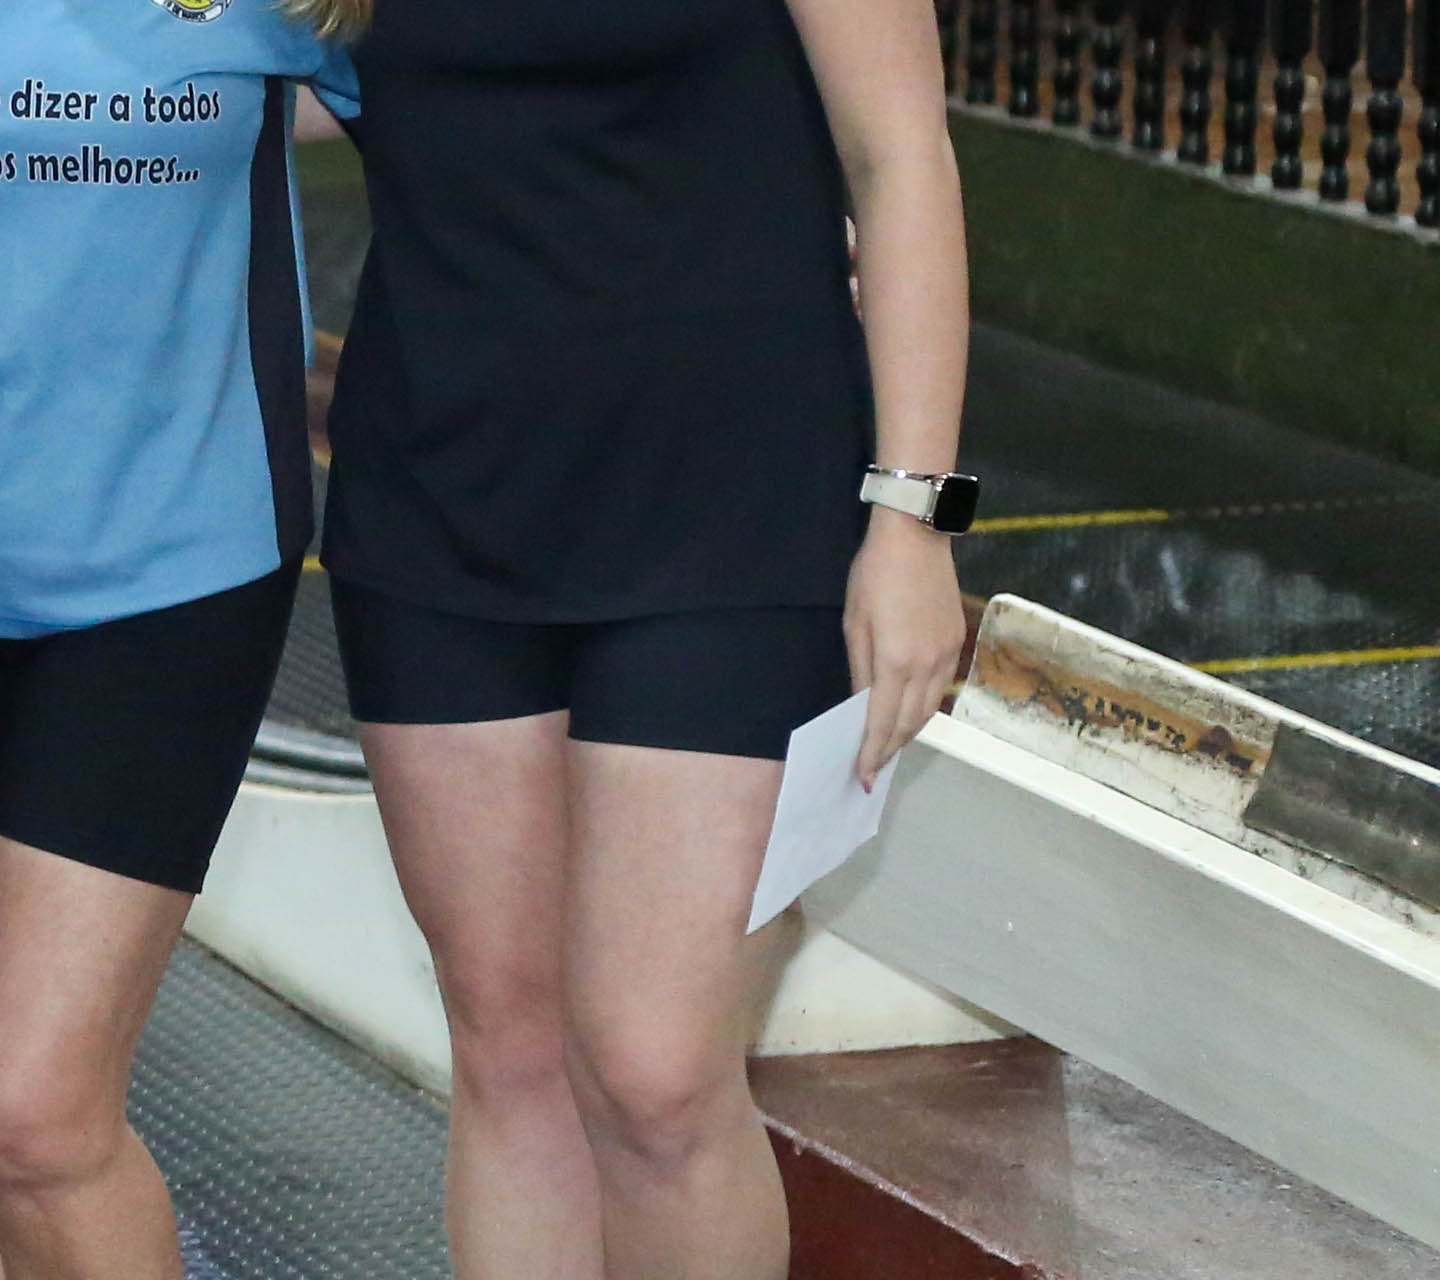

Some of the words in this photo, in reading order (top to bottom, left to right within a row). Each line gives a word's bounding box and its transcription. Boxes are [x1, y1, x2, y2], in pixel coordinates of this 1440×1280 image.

[11, 79, 98, 121] dizer
[110, 93, 131, 122] a
[143, 83, 221, 124] todos
[28, 144, 200, 185] melhores...
